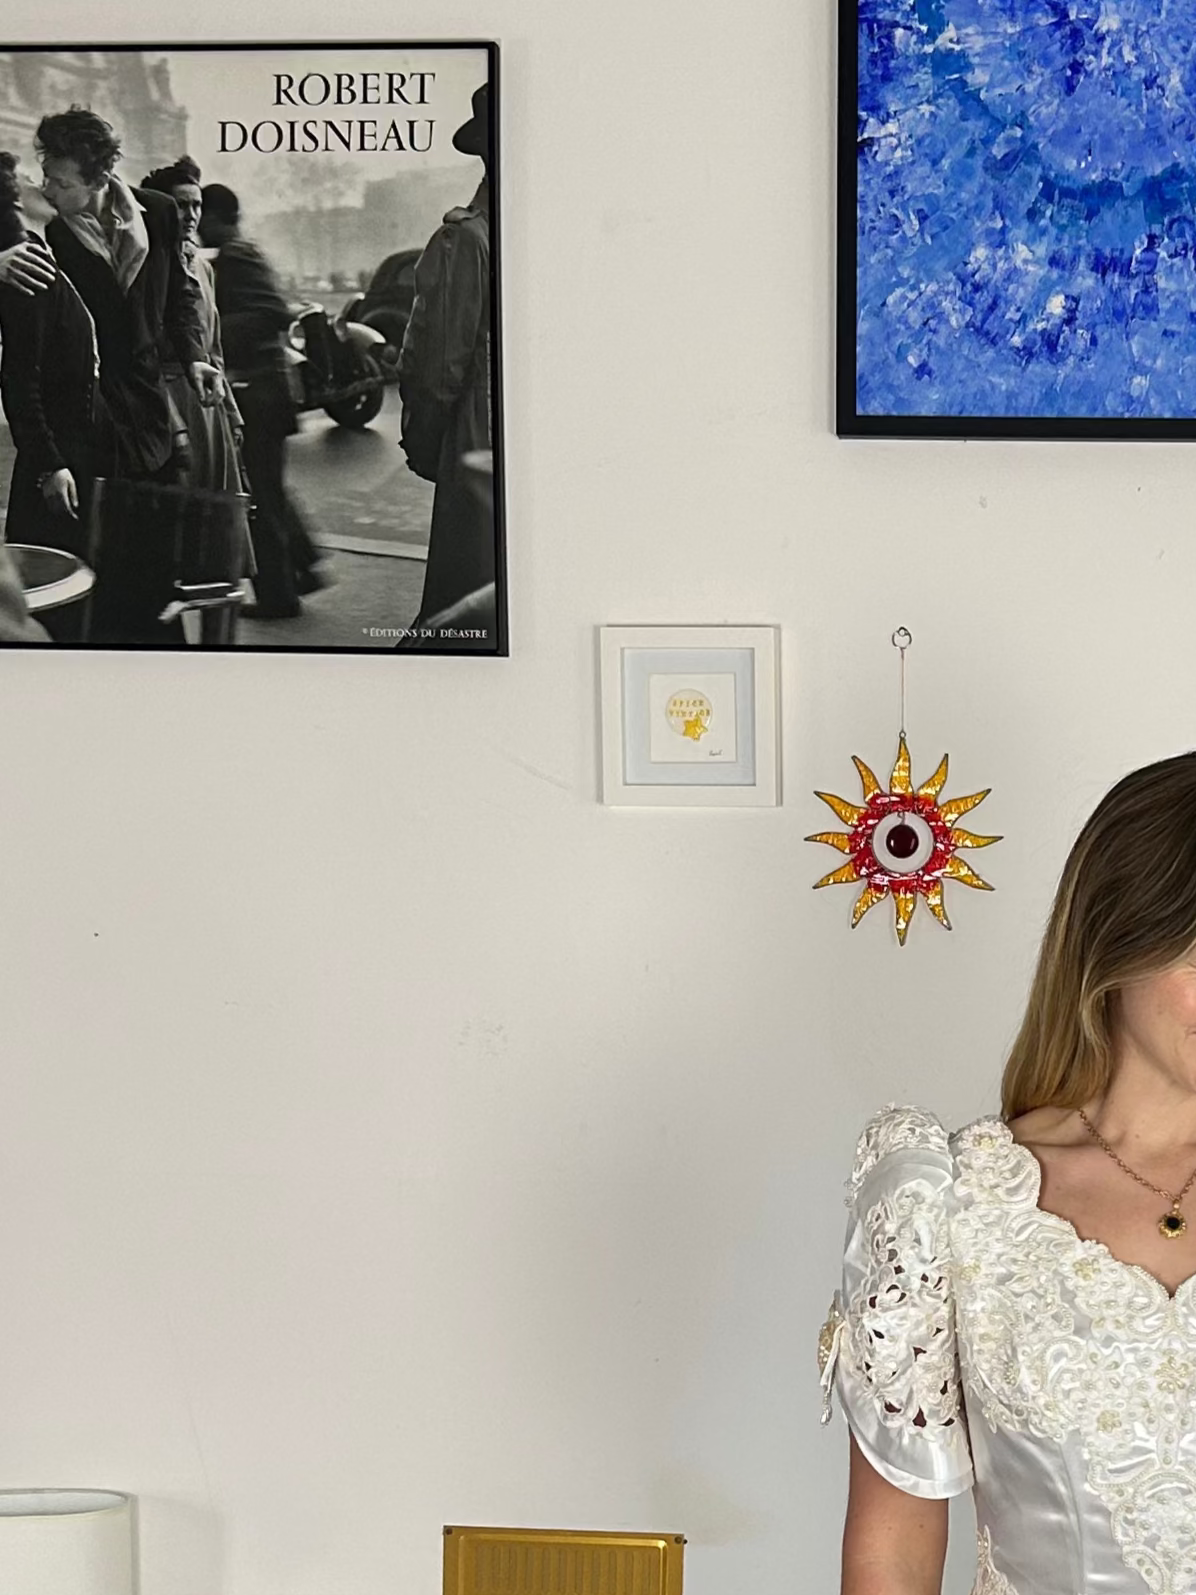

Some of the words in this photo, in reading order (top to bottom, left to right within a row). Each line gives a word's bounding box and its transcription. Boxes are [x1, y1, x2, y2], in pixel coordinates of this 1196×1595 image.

[272, 72, 436, 106] ROBERT
[216, 119, 436, 153] DOISNEAU
[370, 627, 418, 638] ÉDITIONS
[421, 628, 436, 638] DU
[440, 628, 488, 639] DÉSASTRE
